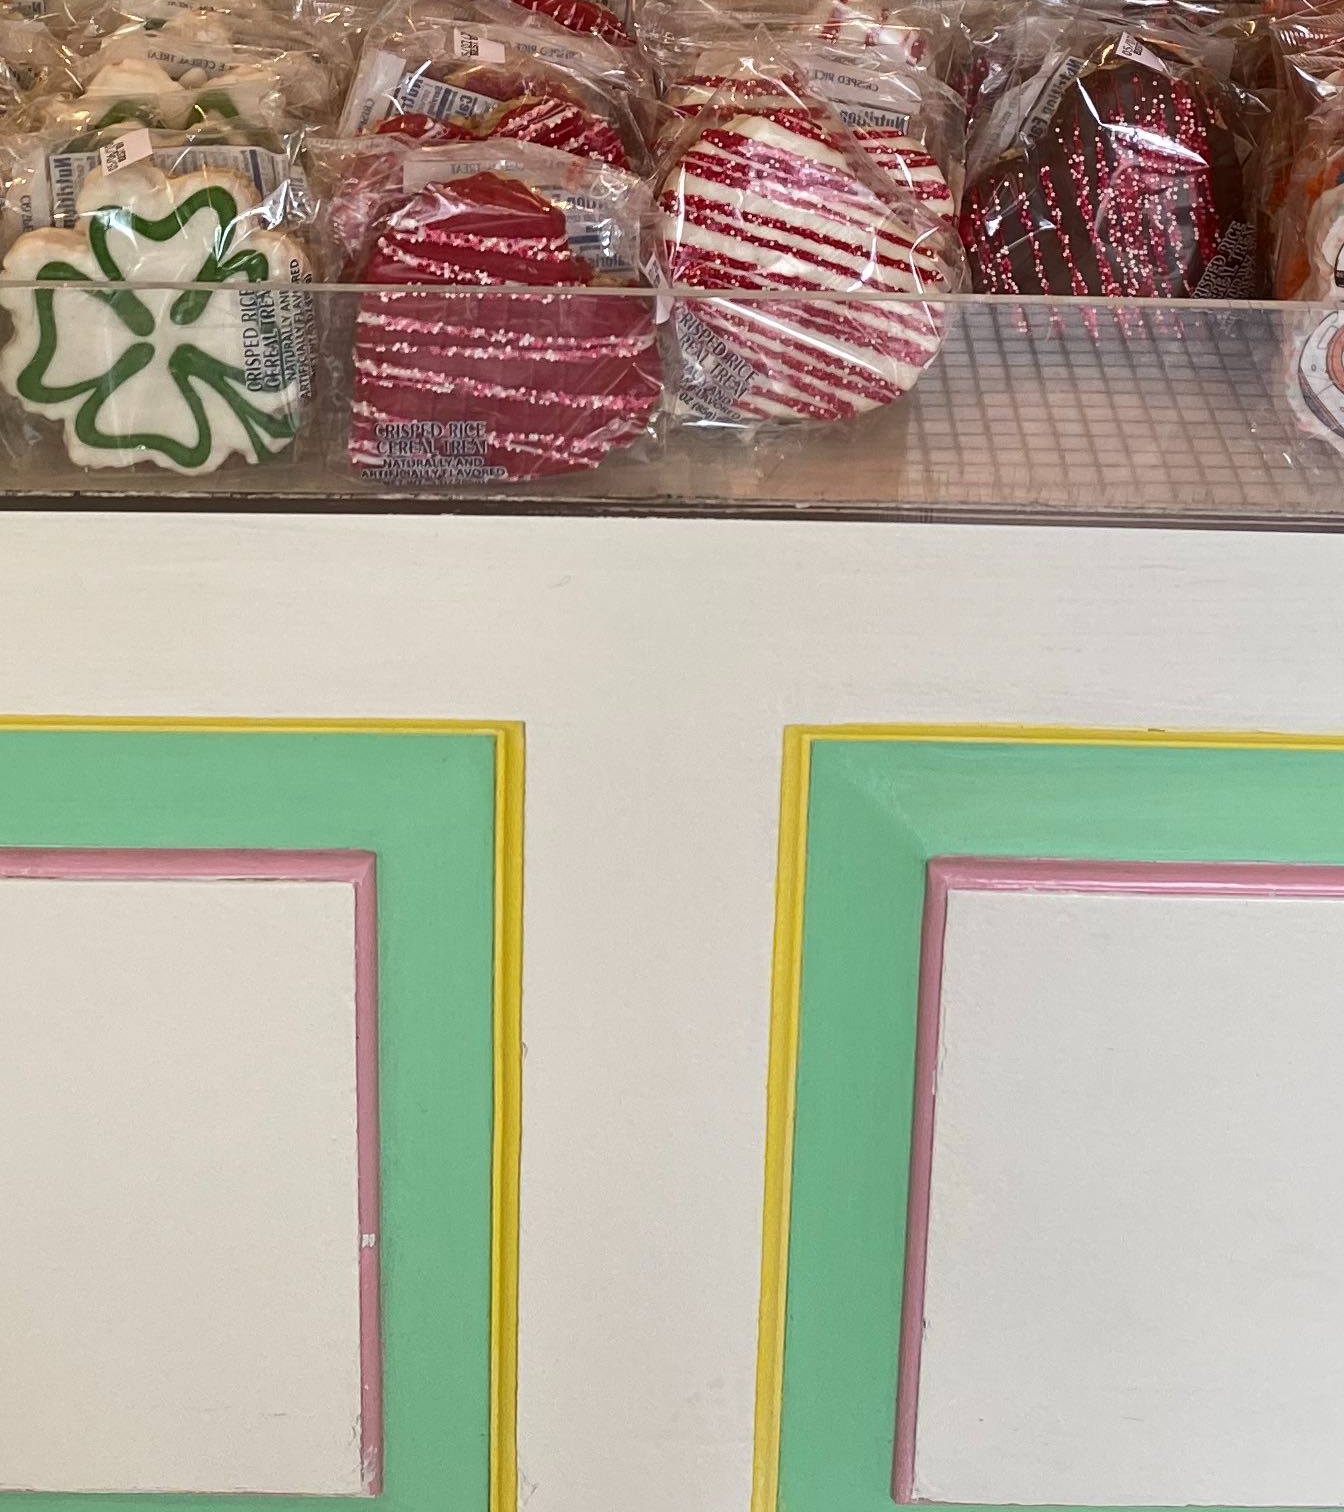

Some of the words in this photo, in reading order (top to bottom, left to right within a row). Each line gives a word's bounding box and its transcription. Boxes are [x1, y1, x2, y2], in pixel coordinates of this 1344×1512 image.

[239, 290, 257, 323] RICE
[243, 328, 263, 392] CRISPED
[262, 329, 281, 388] CEREAL
[281, 316, 297, 381] NATURALLY
[375, 423, 443, 438] CRISPED
[449, 422, 486, 437] RICE
[377, 439, 439, 455] CEREAL
[443, 439, 487, 455] TREAT
[384, 458, 455, 468] NATURALLY
[456, 457, 483, 467] AND
